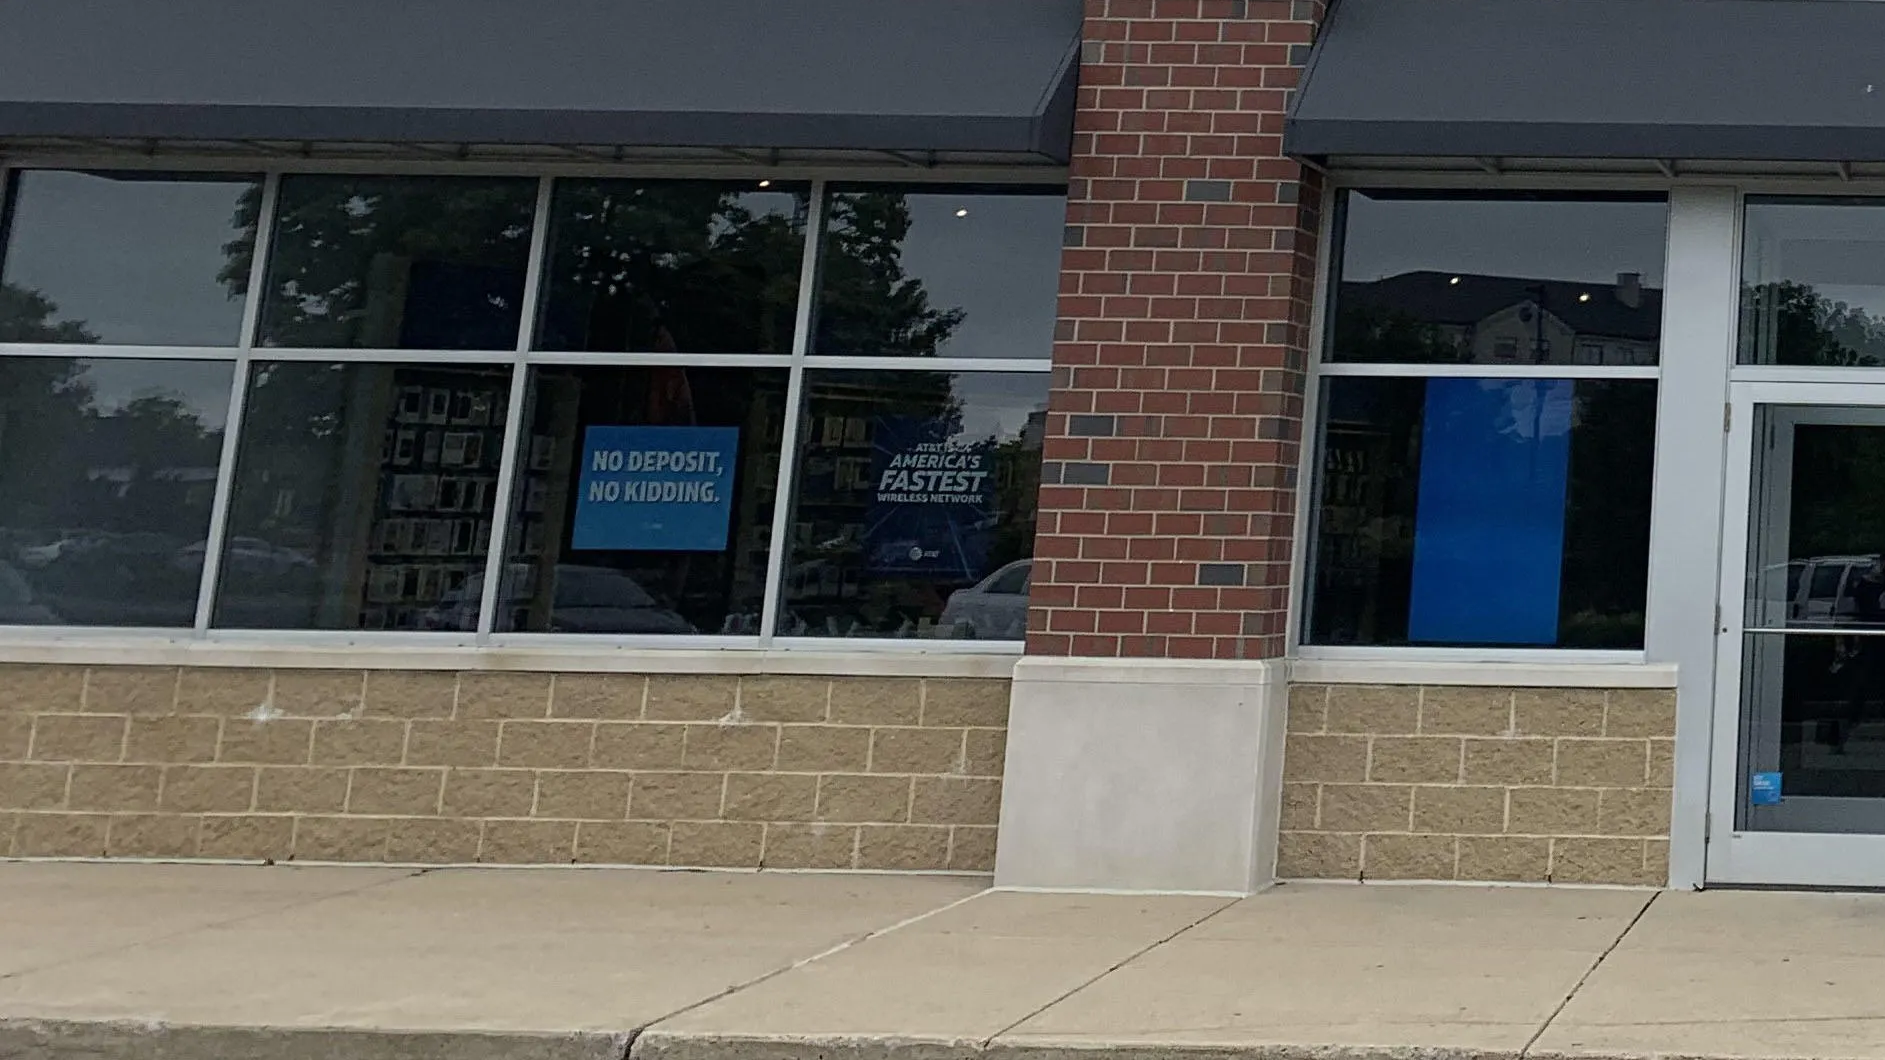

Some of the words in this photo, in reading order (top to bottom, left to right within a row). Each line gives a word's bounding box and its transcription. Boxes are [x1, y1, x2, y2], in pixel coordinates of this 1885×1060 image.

[592, 450, 624, 472] NO
[628, 451, 723, 476] DEPOSIT,
[889, 454, 983, 469] AMERICA'S
[588, 480, 620, 502] NO
[624, 481, 720, 503] KIDDING.
[879, 470, 988, 492] FASTEST
[877, 493, 929, 503] WIRELESS
[931, 494, 983, 504] NETWORK
